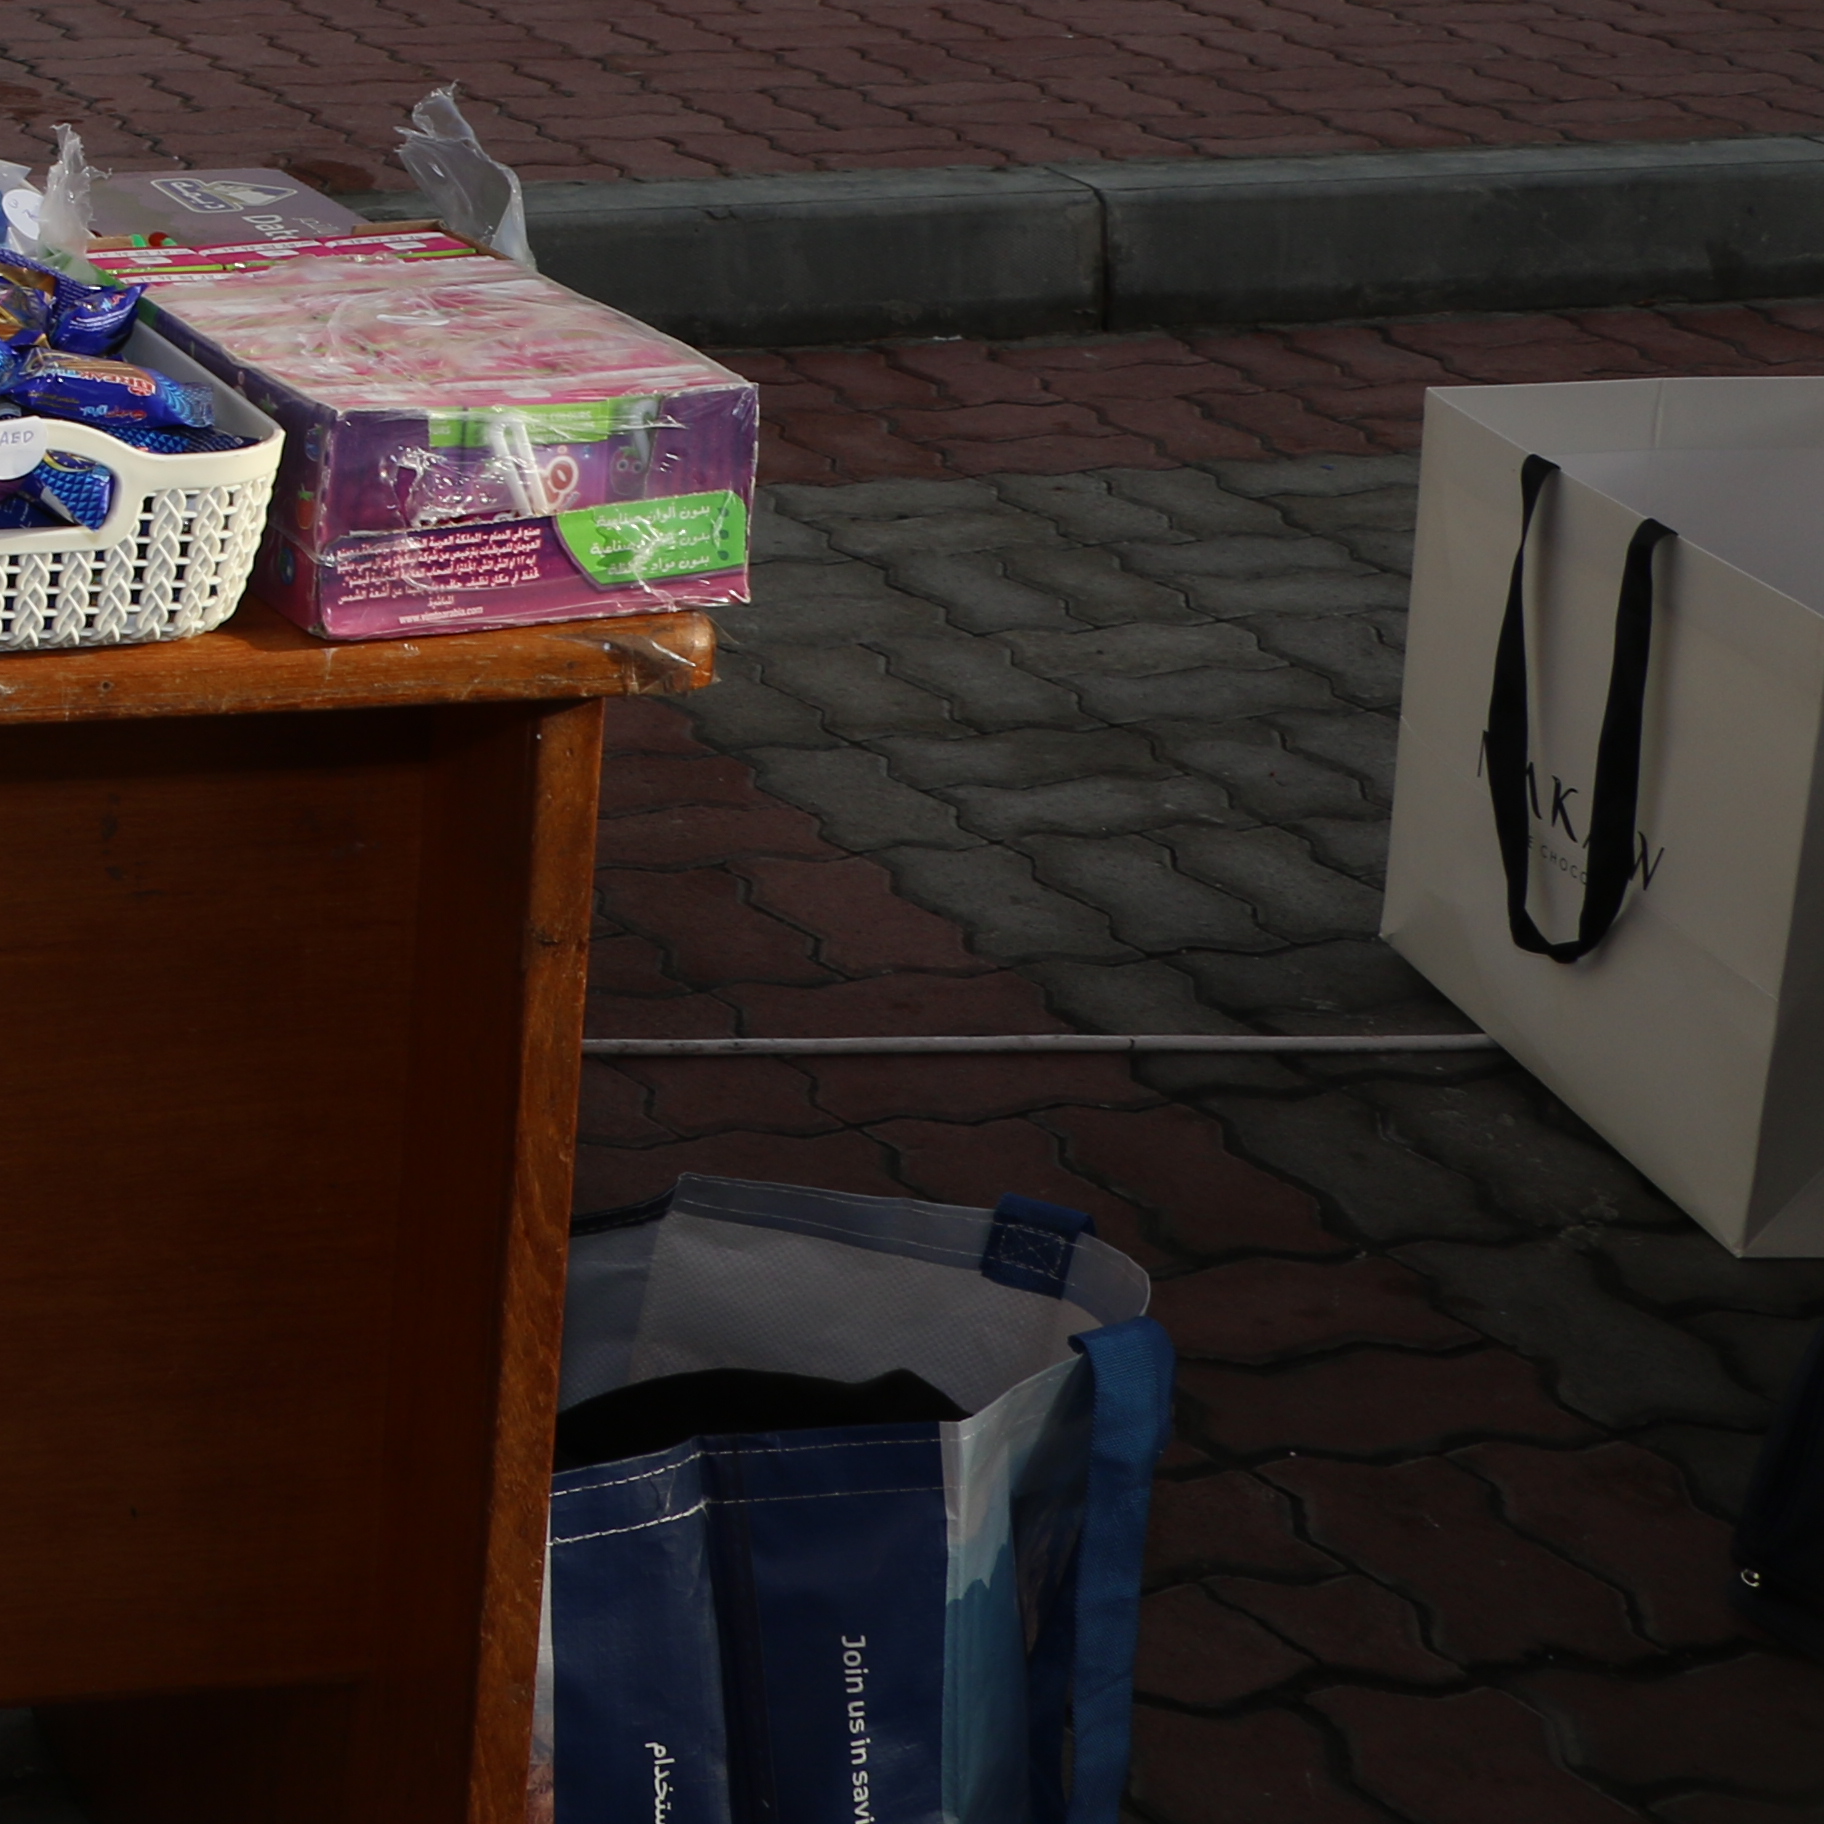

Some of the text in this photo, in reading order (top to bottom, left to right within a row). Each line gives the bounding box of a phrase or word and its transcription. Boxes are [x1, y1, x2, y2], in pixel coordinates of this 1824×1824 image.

[679, 505, 711, 520] بدون
[678, 555, 711, 570] بدون
[841, 1635, 875, 1824] Join us in savi
[645, 1742, 675, 1824] ستخدام
